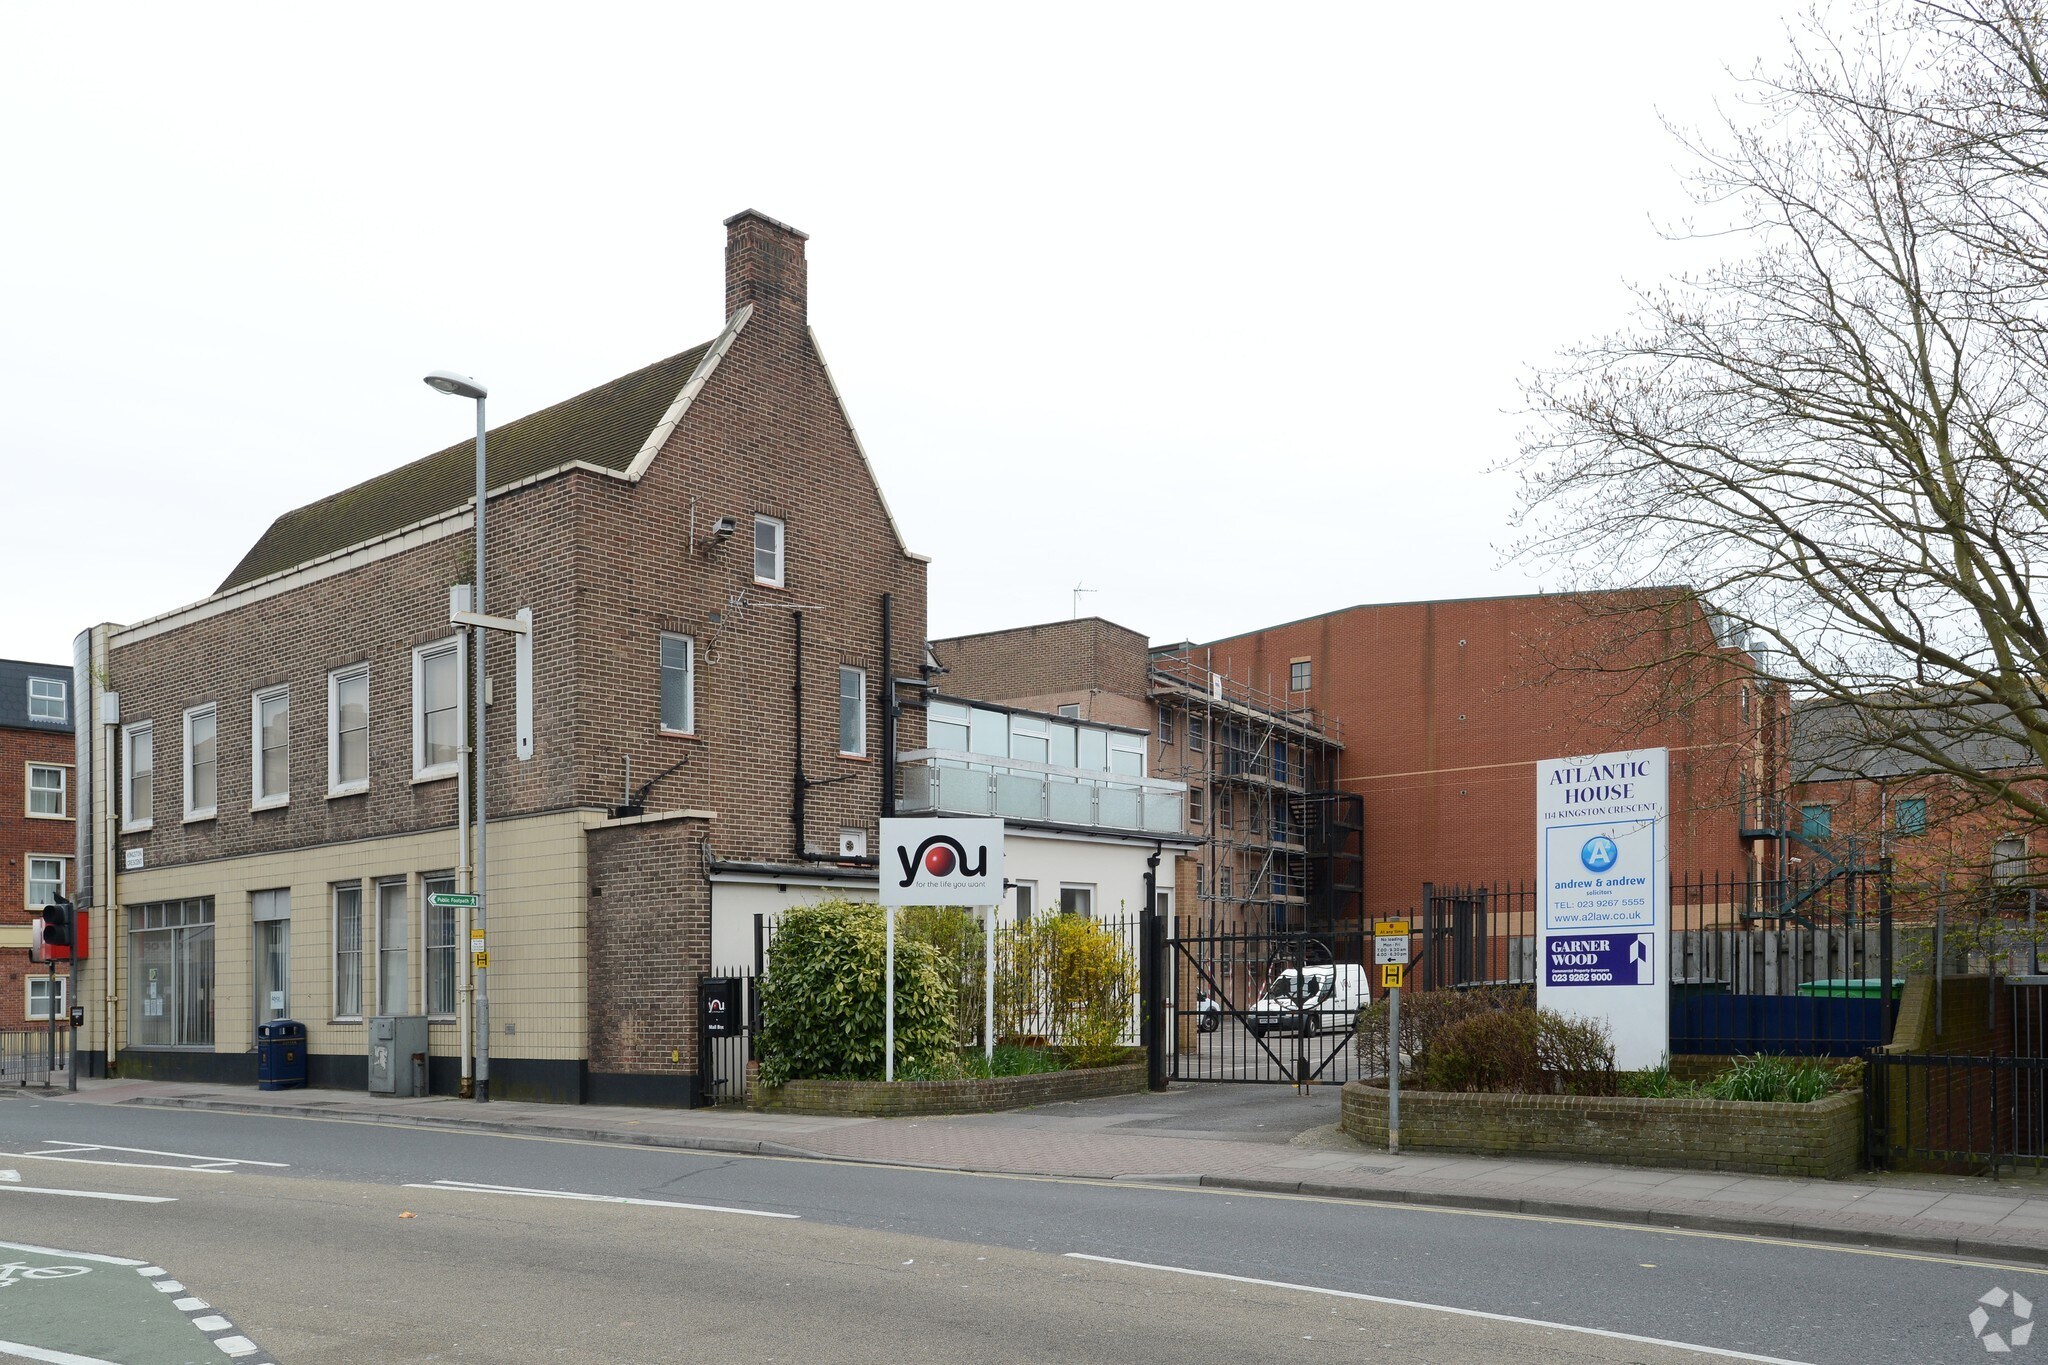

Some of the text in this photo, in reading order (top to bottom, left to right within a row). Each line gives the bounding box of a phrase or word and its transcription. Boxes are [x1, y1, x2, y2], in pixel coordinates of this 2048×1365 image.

[1550, 760, 1650, 785] ATLANTIC
[1565, 783, 1635, 804] HOUSE
[1558, 807, 1606, 819] KINGSTON
[1608, 802, 1657, 815] CRESCENT
[897, 835, 987, 887] you
[1554, 876, 1646, 889] andrew & andrew
[1596, 899, 1619, 908] 9267
[1621, 898, 1645, 906] 5555
[1554, 911, 1641, 922] www.a2law.co.uk
[1551, 940, 1610, 952] GARNER
[1551, 953, 1598, 966] WOOD
[1385, 966, 1399, 984] H
[1551, 973, 1613, 982] 023 9262 9000
